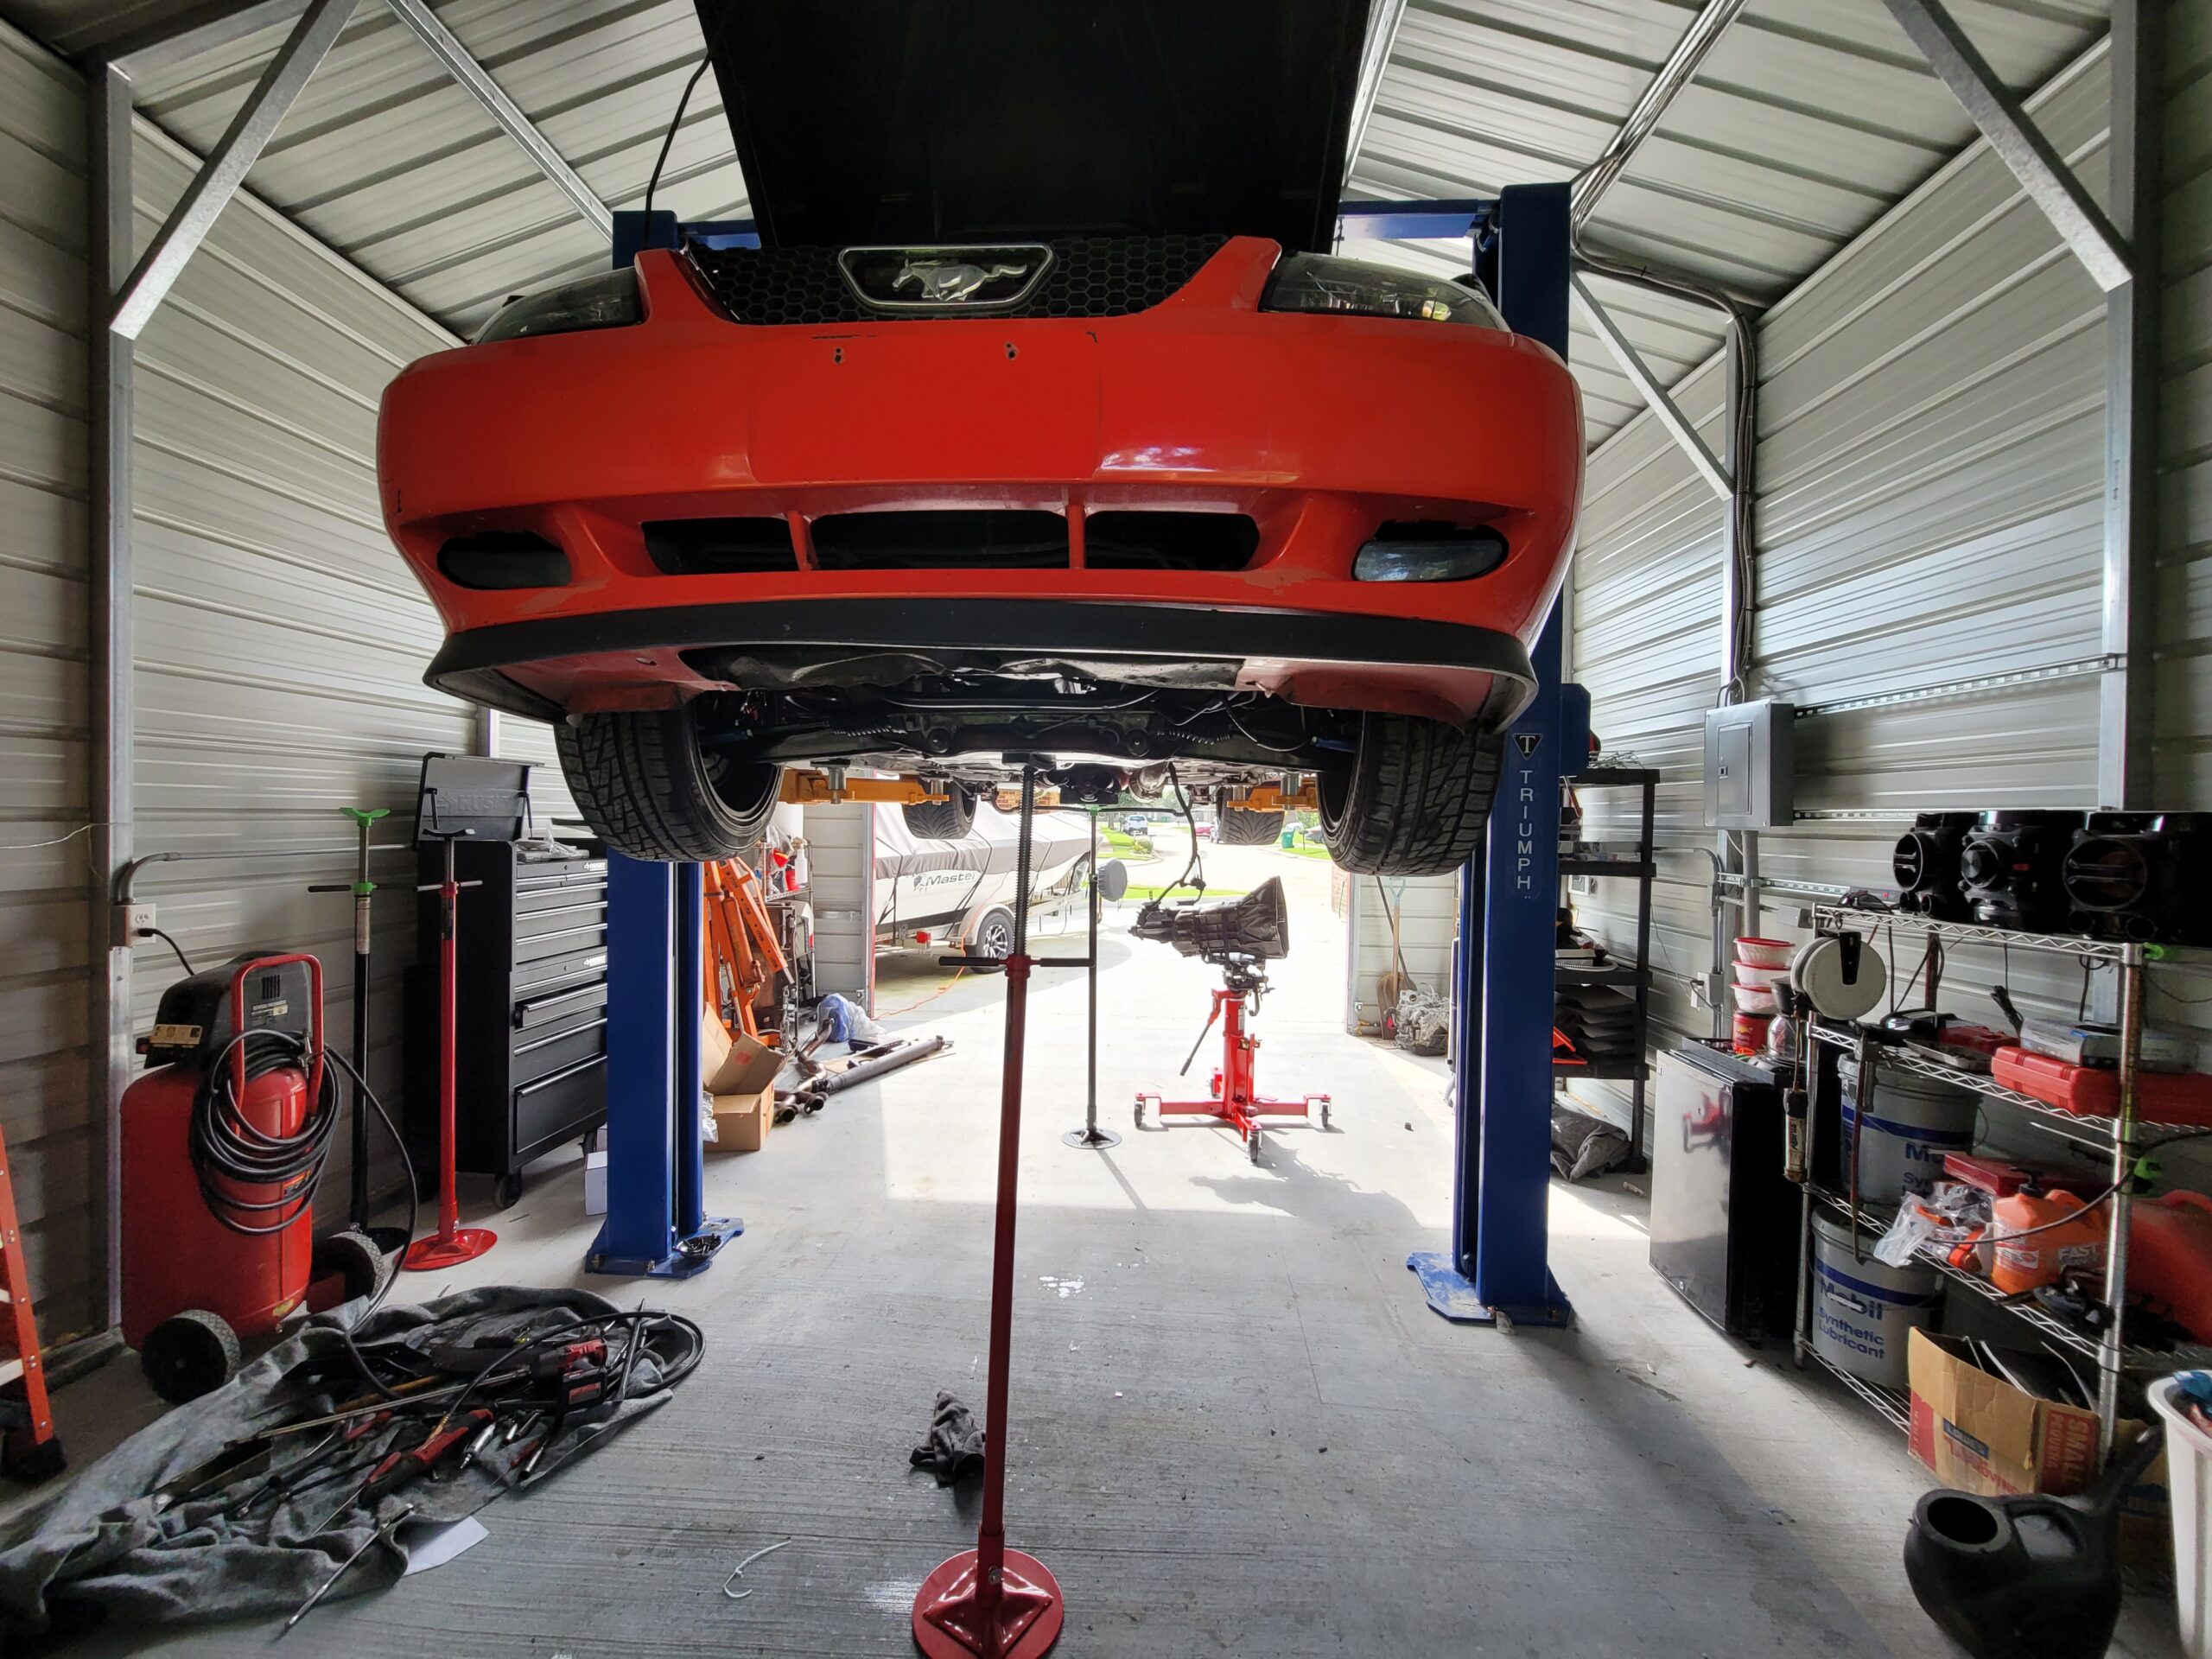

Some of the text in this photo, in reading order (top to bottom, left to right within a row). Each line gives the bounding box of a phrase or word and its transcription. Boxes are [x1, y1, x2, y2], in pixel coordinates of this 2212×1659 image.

[1517, 770, 1534, 889] TRIUMPH
[1820, 1279, 1884, 1321] Mobil
[1818, 1306, 1885, 1345] Synthetic
[1818, 1319, 1885, 1359] Lubricant
[2061, 1418, 2089, 1484] SMALL
